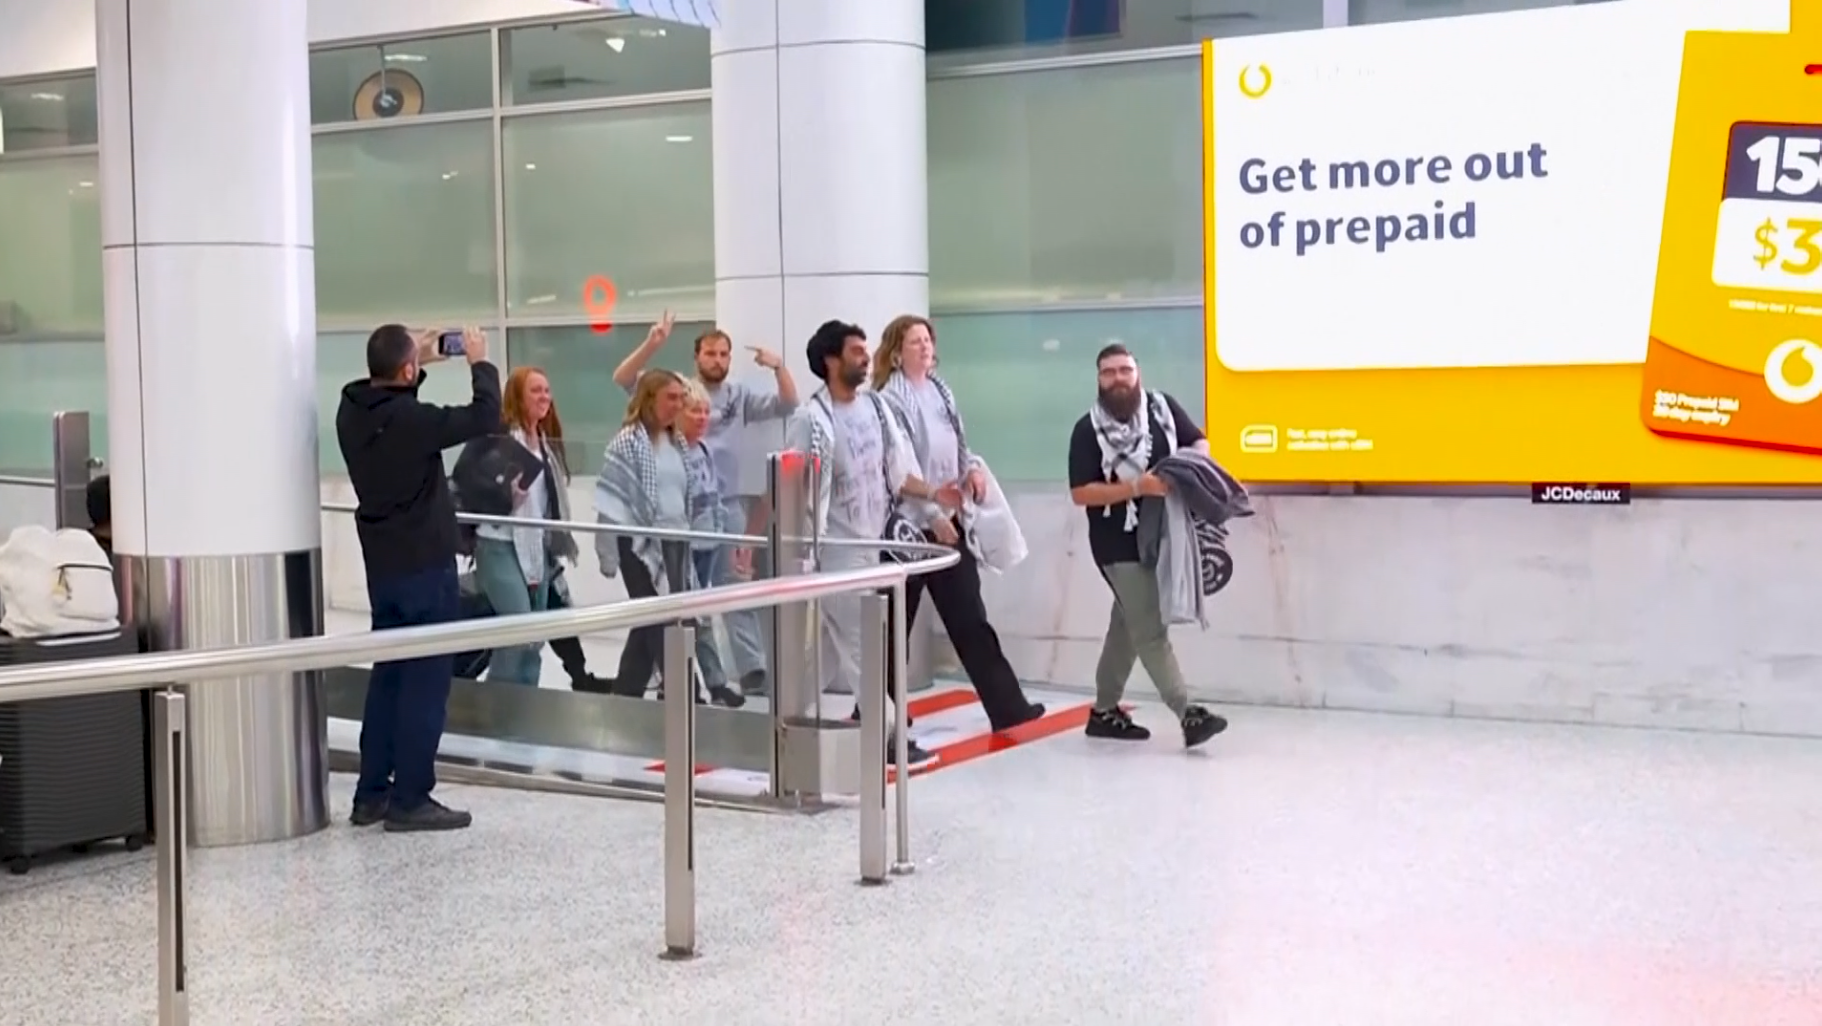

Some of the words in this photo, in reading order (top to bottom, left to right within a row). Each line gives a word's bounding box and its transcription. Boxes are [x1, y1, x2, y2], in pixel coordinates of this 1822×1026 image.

[1238, 157, 1318, 195] Get
[1328, 155, 1453, 190] more
[1463, 142, 1549, 182] out
[1746, 136, 1822, 195] 15
[1239, 210, 1287, 249] of
[1295, 200, 1476, 257] prepaid
[1541, 486, 1621, 501] JCDecaux
